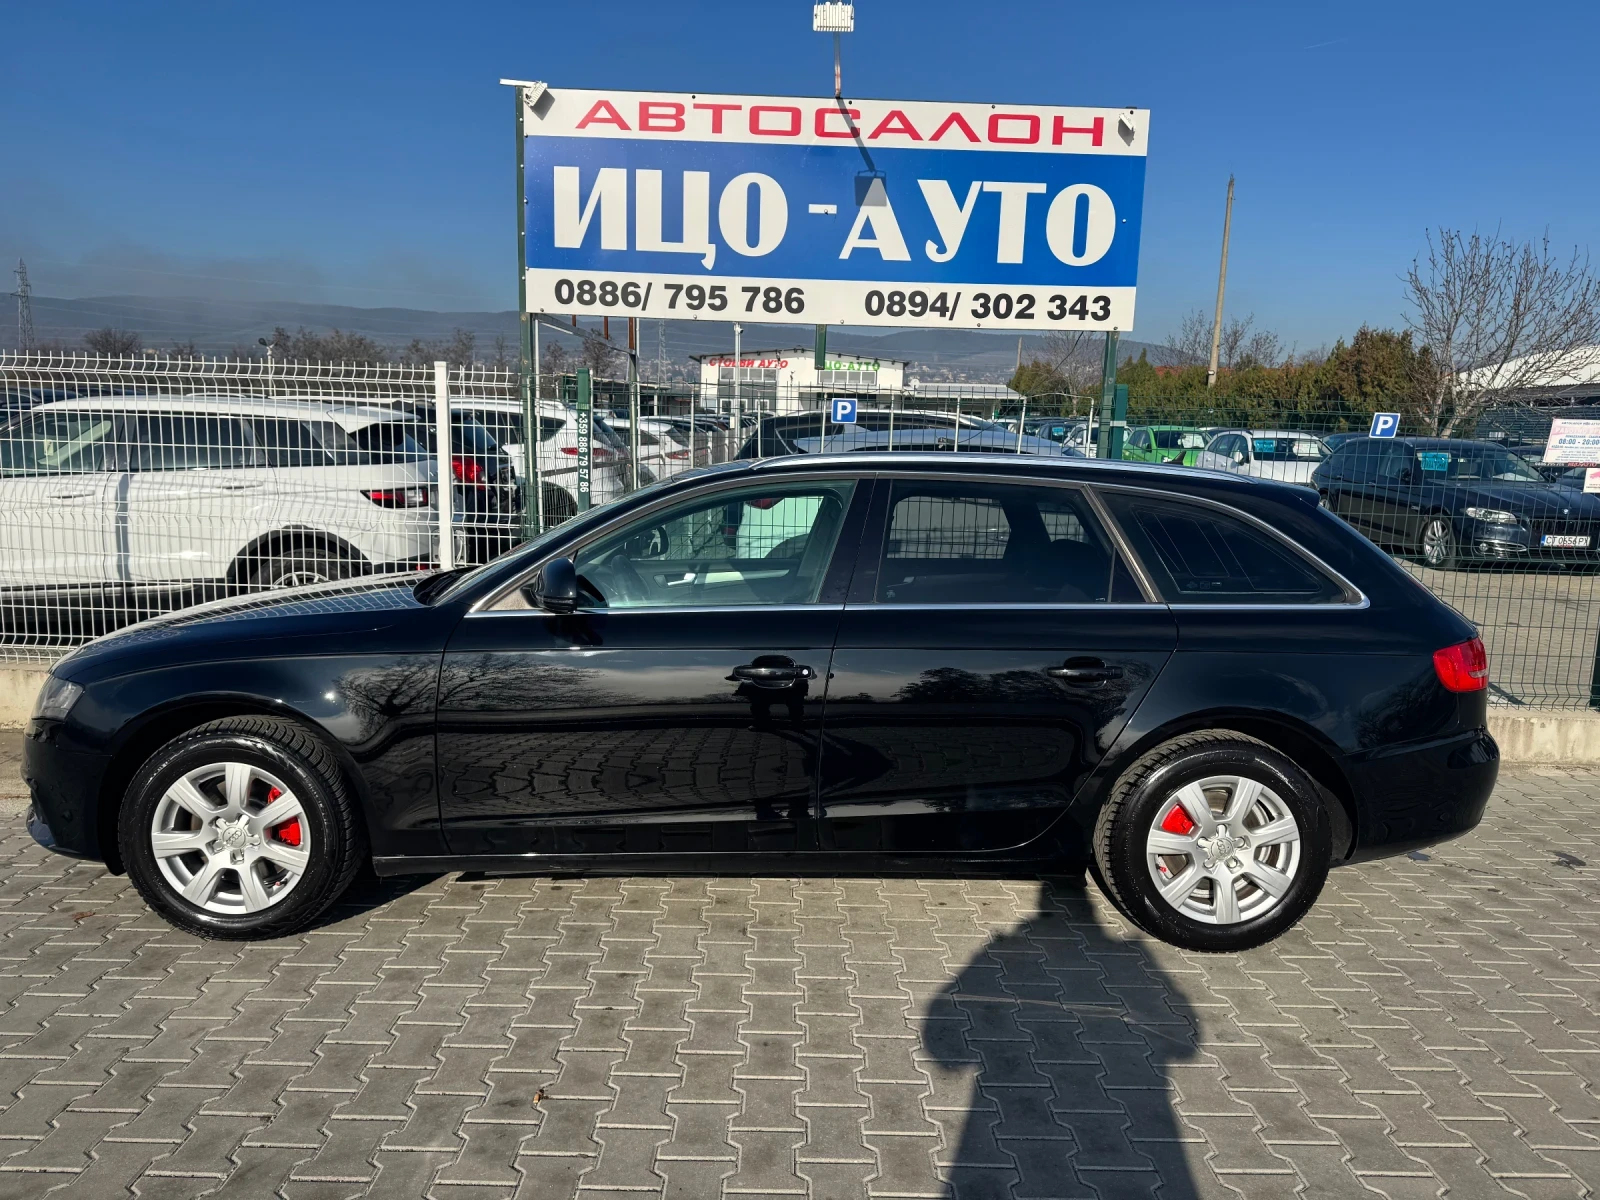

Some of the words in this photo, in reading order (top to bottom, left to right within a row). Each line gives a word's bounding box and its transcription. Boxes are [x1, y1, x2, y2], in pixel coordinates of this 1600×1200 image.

[575, 99, 1104, 147] АВТОСАЛОН
[554, 278, 653, 311] 0886/
[663, 283, 728, 311] 795
[741, 286, 806, 314] 786
[864, 289, 962, 321] 0894/
[970, 292, 1036, 320] 302
[1046, 294, 1112, 321] 343
[825, 361, 881, 371] ЦО-АУТО
[836, 402, 851, 420] P
[1376, 416, 1394, 435] P
[578, 436, 588, 453] 886
[579, 455, 588, 467] 79
[579, 468, 589, 479] 57
[580, 481, 589, 493] 86
